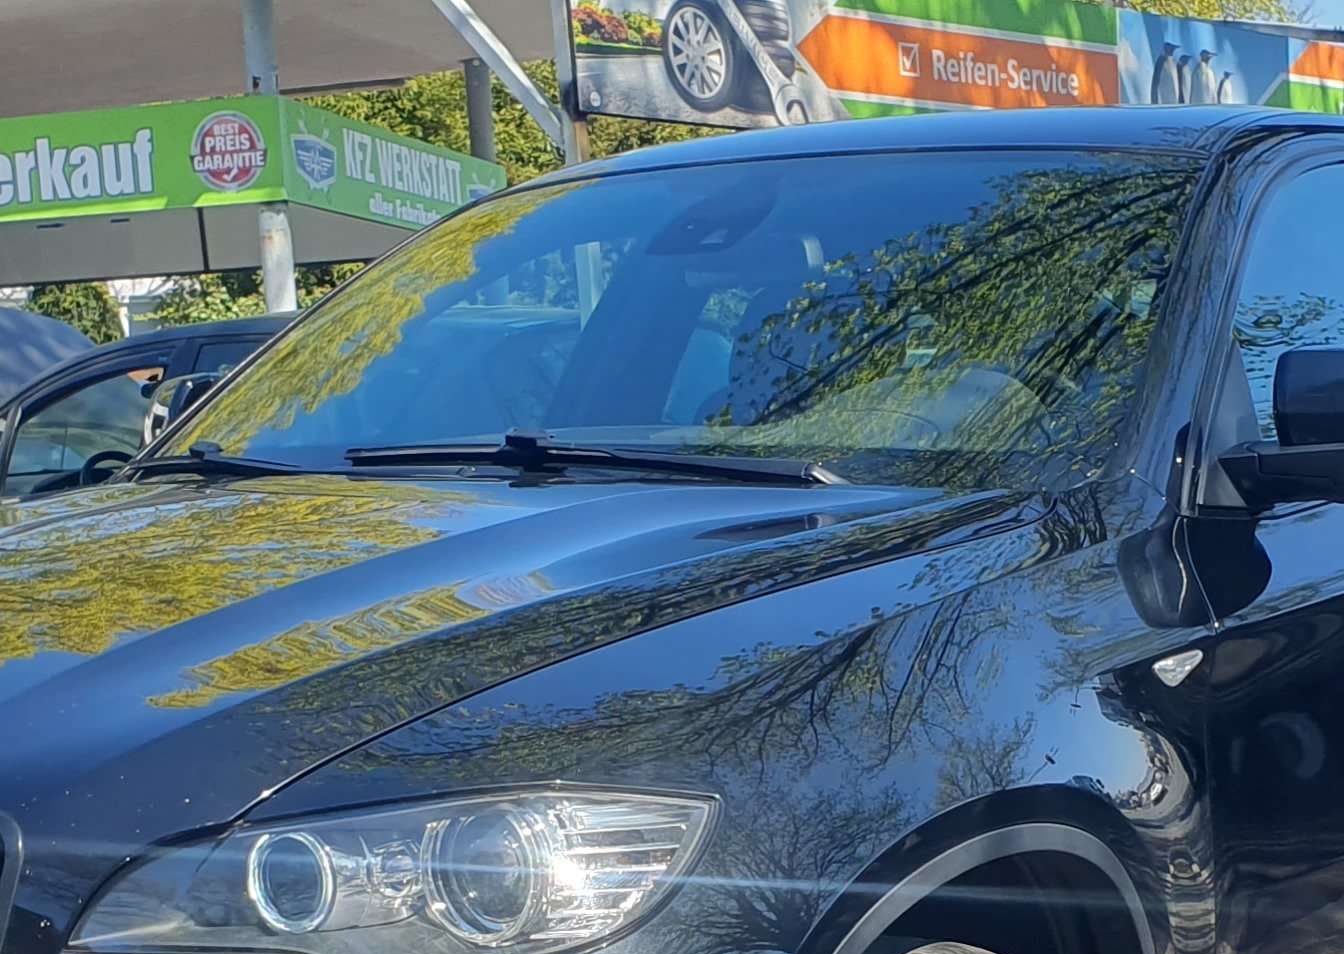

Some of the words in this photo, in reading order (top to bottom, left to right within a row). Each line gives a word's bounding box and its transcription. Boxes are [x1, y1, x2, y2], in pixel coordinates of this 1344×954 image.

[931, 49, 1078, 96] Reifen-Service
[213, 122, 240, 136] BEST
[204, 132, 252, 154] PREIS
[192, 150, 266, 172] GARANTIE
[342, 127, 376, 184] KFZ
[375, 137, 463, 206] WERKSTATT
